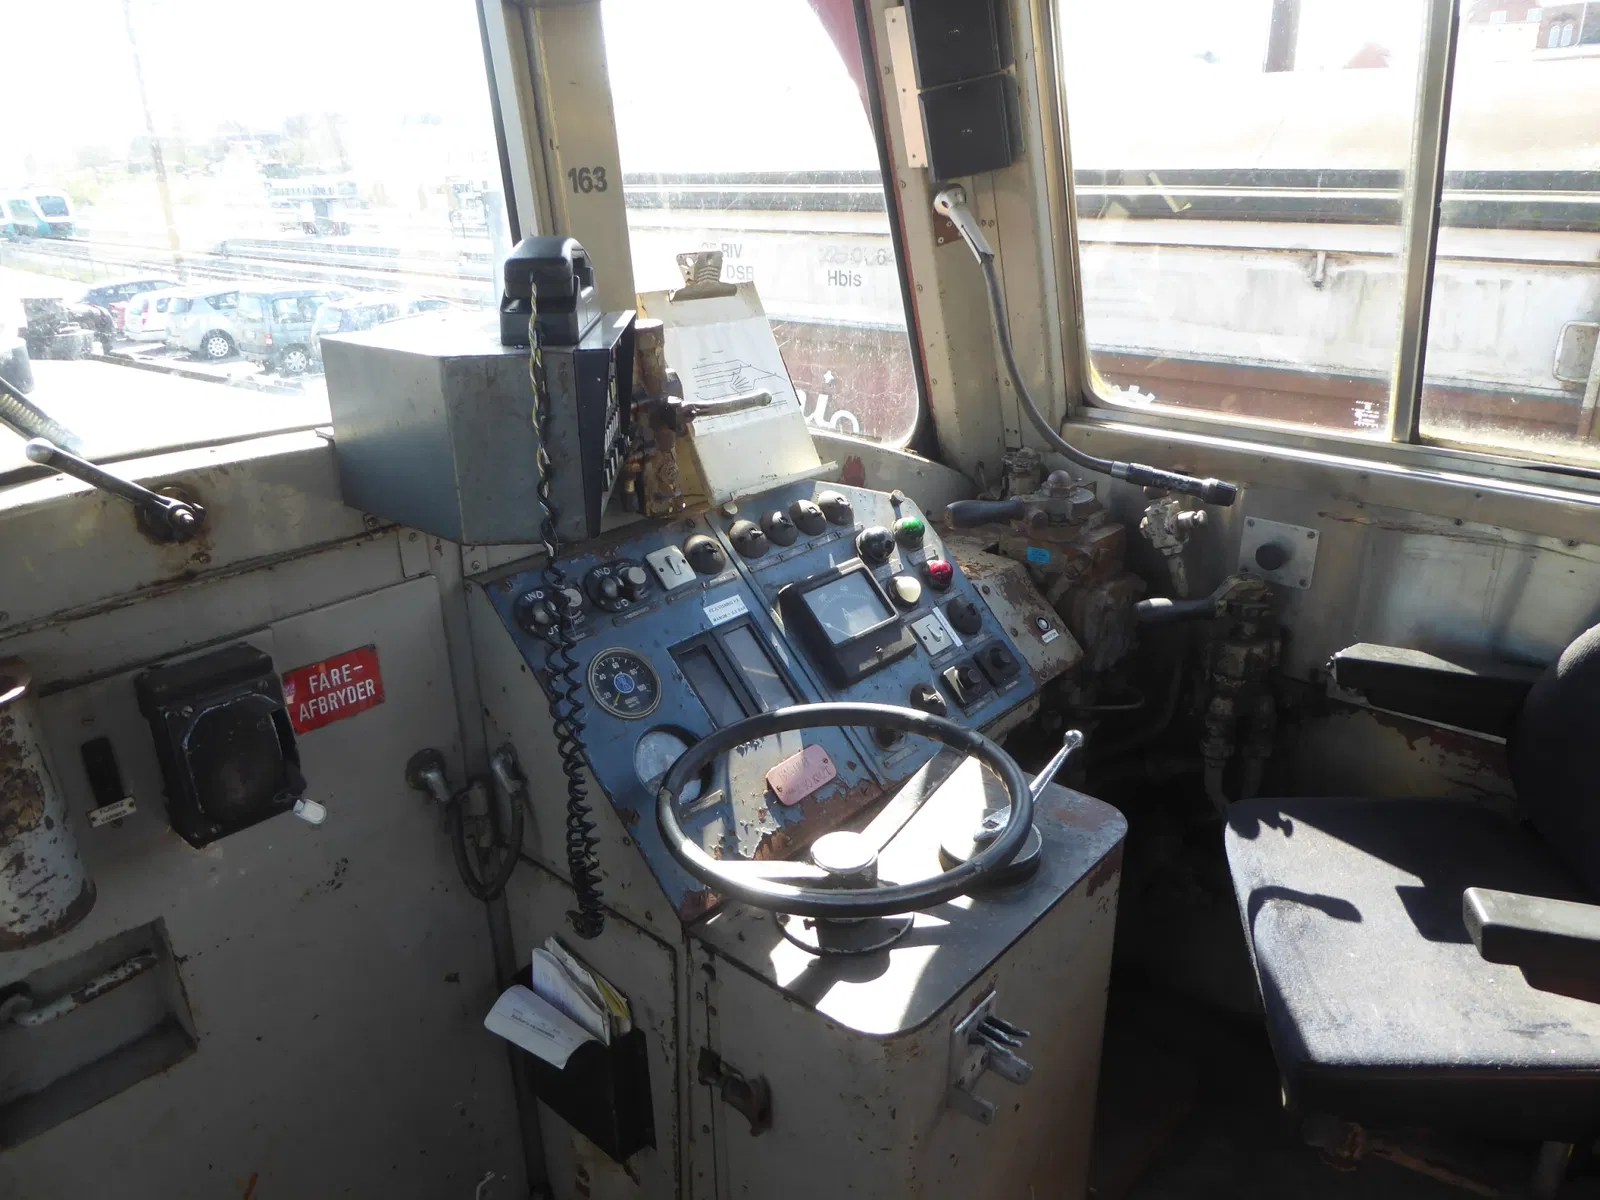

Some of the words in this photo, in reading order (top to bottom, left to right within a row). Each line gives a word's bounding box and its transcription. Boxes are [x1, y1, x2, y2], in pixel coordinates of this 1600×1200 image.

[567, 165, 608, 194] 163
[721, 243, 743, 259] RIV
[827, 270, 862, 287] Hbis
[593, 567, 611, 578] IND
[524, 590, 545, 602] IND
[308, 663, 363, 694] FARE-
[299, 679, 376, 722] AFBRYDER
